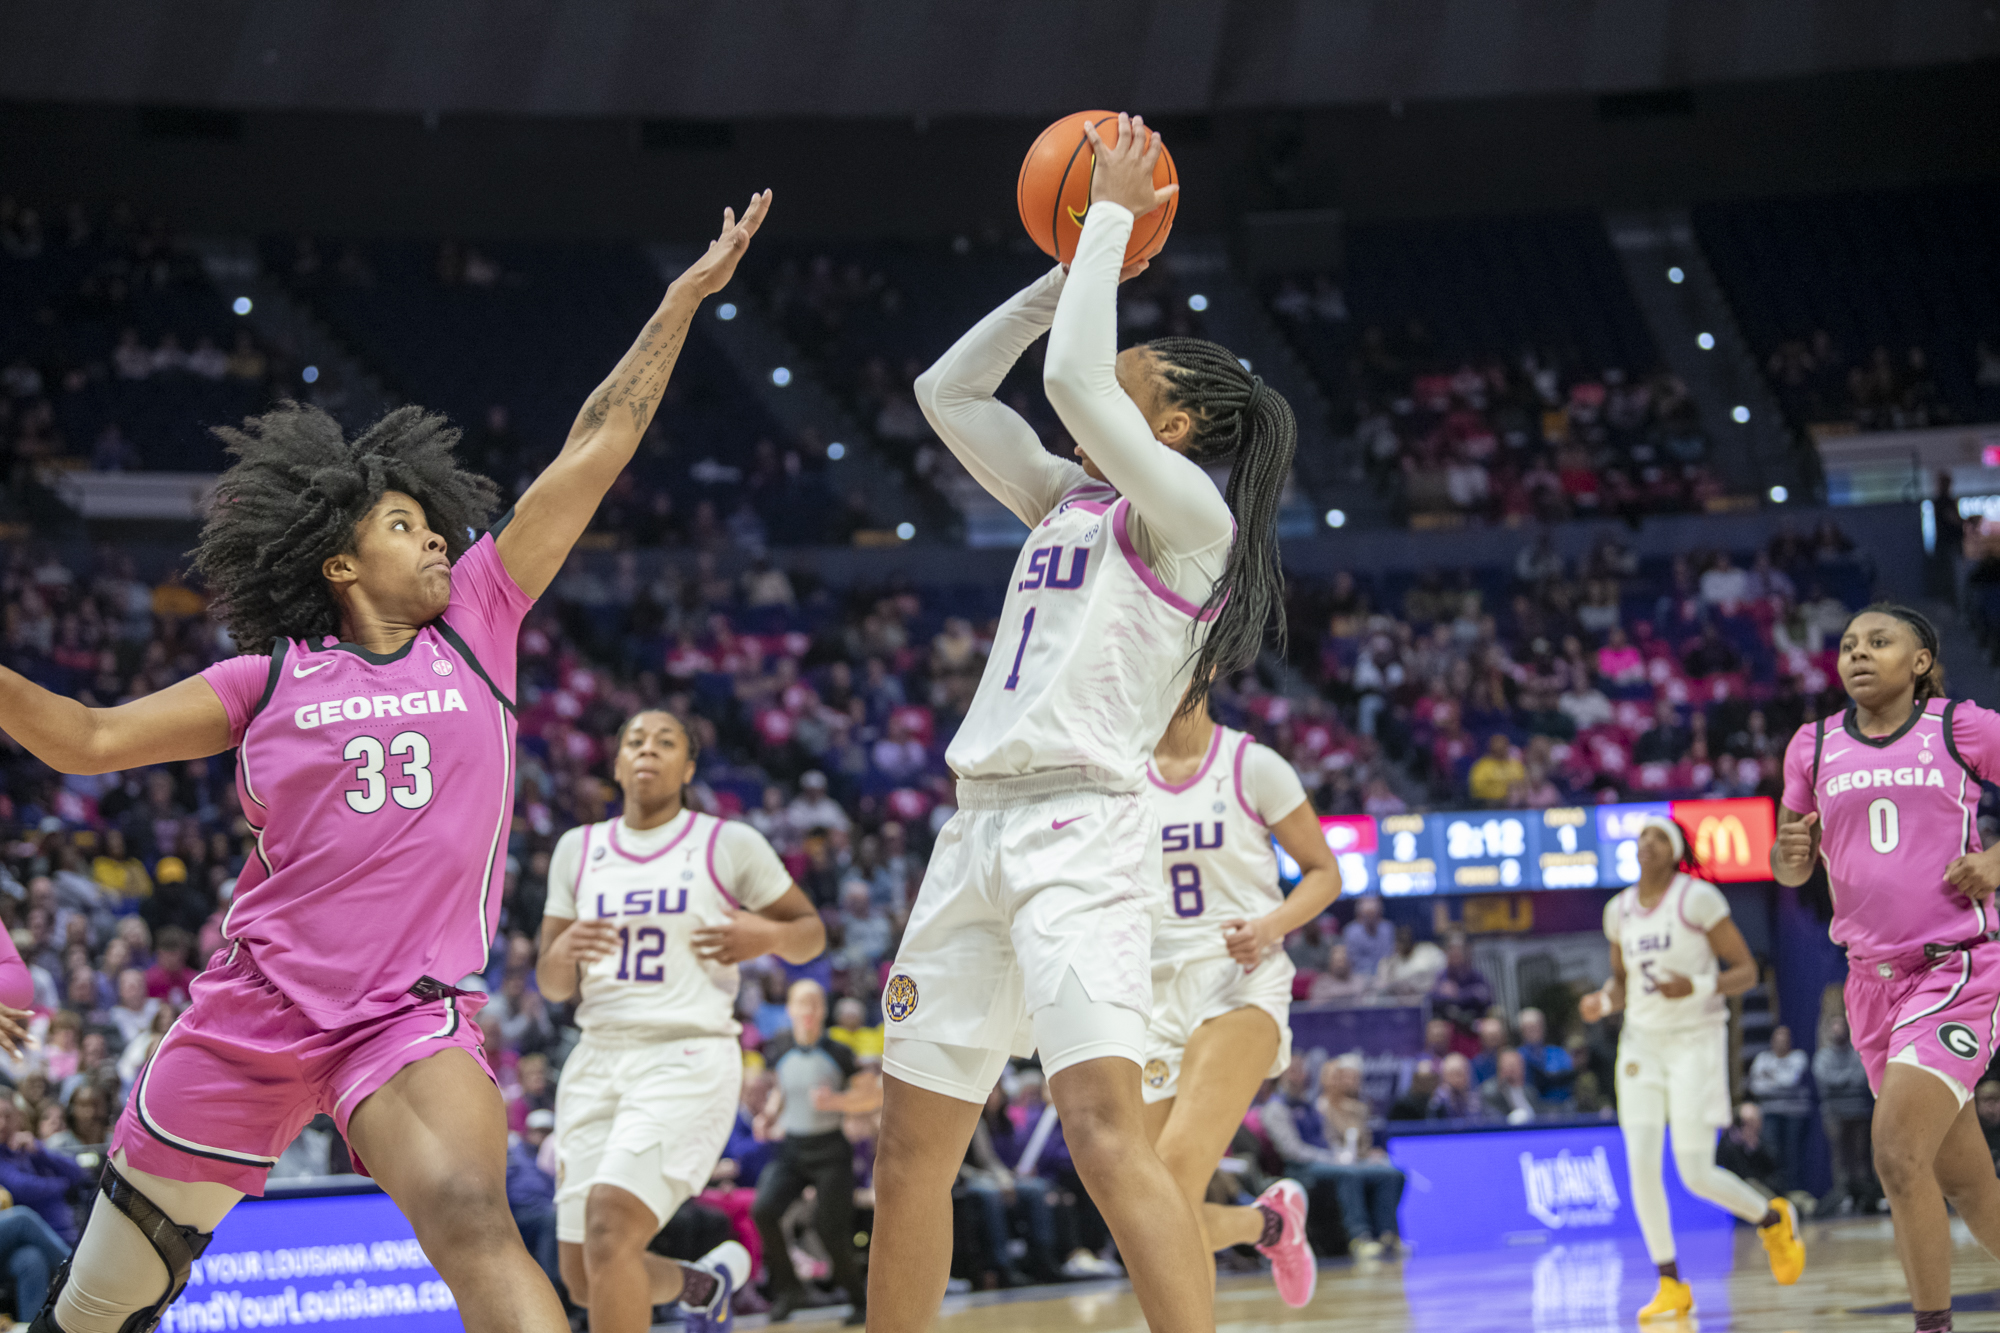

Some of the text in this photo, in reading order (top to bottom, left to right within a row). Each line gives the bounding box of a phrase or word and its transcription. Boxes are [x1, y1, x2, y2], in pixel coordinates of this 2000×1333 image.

[1018, 546, 1090, 593] SU
[1004, 607, 1036, 691] 1
[294, 688, 469, 730] GEORGIA
[343, 730, 433, 815] 33
[1826, 767, 1945, 797] GEORGIA
[1162, 821, 1224, 852] SU
[1868, 797, 1900, 855] 0
[597, 887, 688, 919] LSU
[1170, 863, 1204, 918] 8
[616, 926, 666, 982] 12
